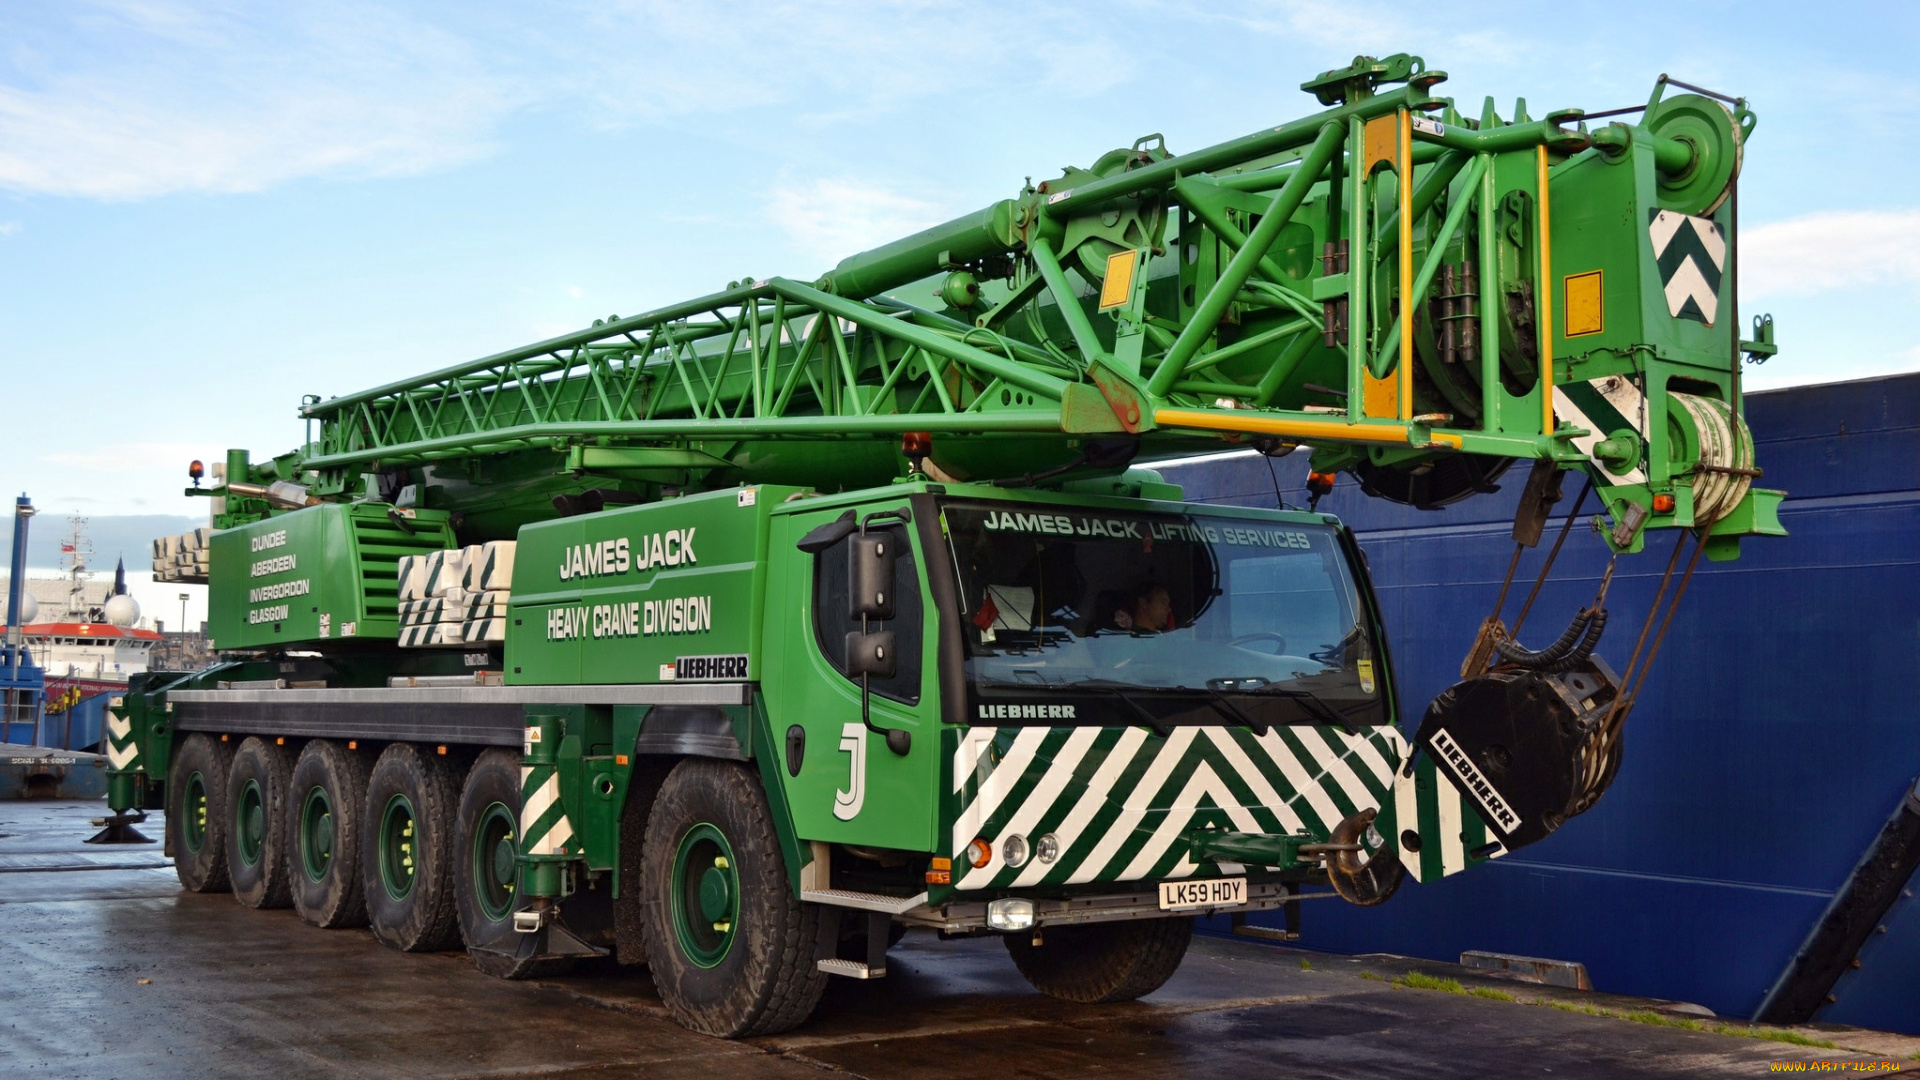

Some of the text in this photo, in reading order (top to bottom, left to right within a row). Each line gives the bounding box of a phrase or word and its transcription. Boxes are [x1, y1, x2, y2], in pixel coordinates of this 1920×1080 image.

[251, 530, 286, 552] DUNDEE
[984, 511, 1311, 550] JAMES JACK LIFTING SERVICES
[251, 554, 296, 577] ABERDEEN
[559, 527, 697, 581] JAMES JACK
[250, 579, 310, 603] INVERGORDON
[250, 604, 288, 624] GLASGOW
[547, 596, 711, 640] HEAVY CRANE DIVISION
[676, 656, 748, 679] LIEBHERR
[978, 704, 1076, 719] LIEBHERR
[1435, 733, 1515, 828] LIEBHERR
[1166, 881, 1240, 905] LK59 HDY
